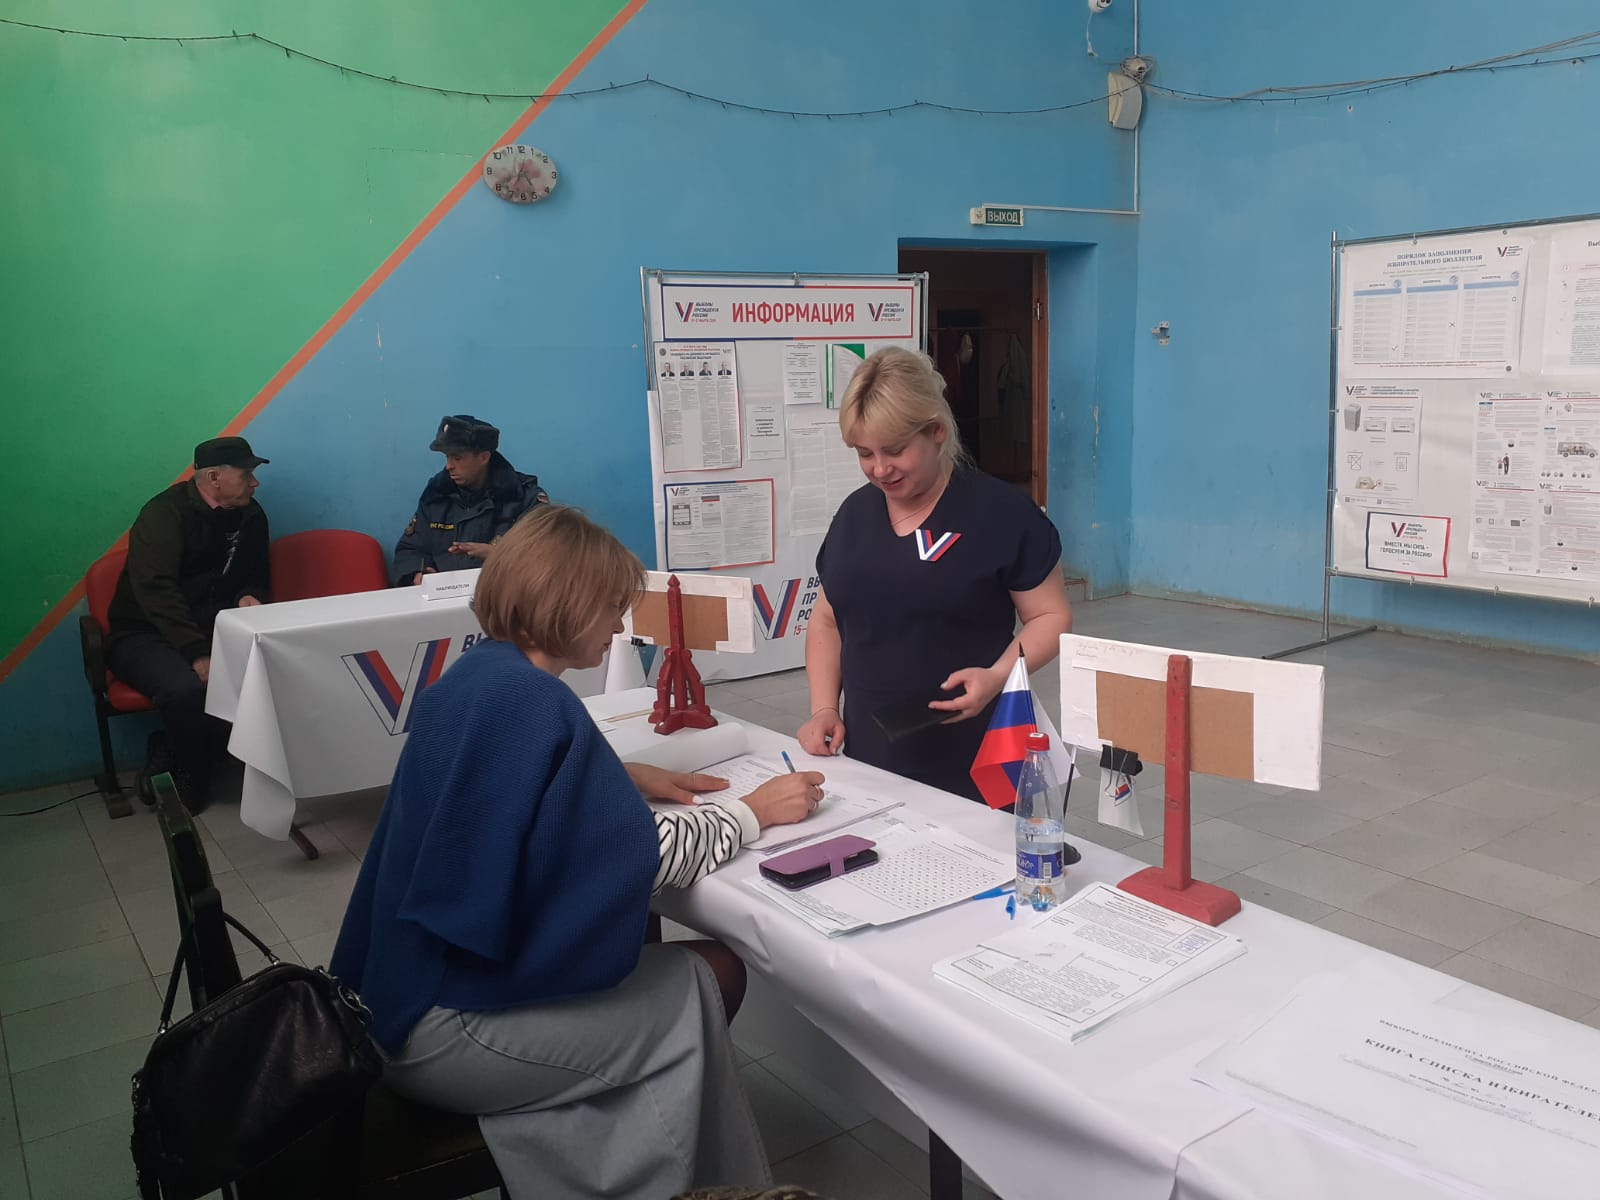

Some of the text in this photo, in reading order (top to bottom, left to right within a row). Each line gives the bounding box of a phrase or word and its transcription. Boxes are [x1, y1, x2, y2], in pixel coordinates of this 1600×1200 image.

[987, 210, 1018, 223] ВЫХОД
[732, 301, 855, 325] ИНФОРМАЦИЯ
[1365, 1037, 1413, 1058] КНИГА
[1419, 1057, 1481, 1083] СПИСКА
